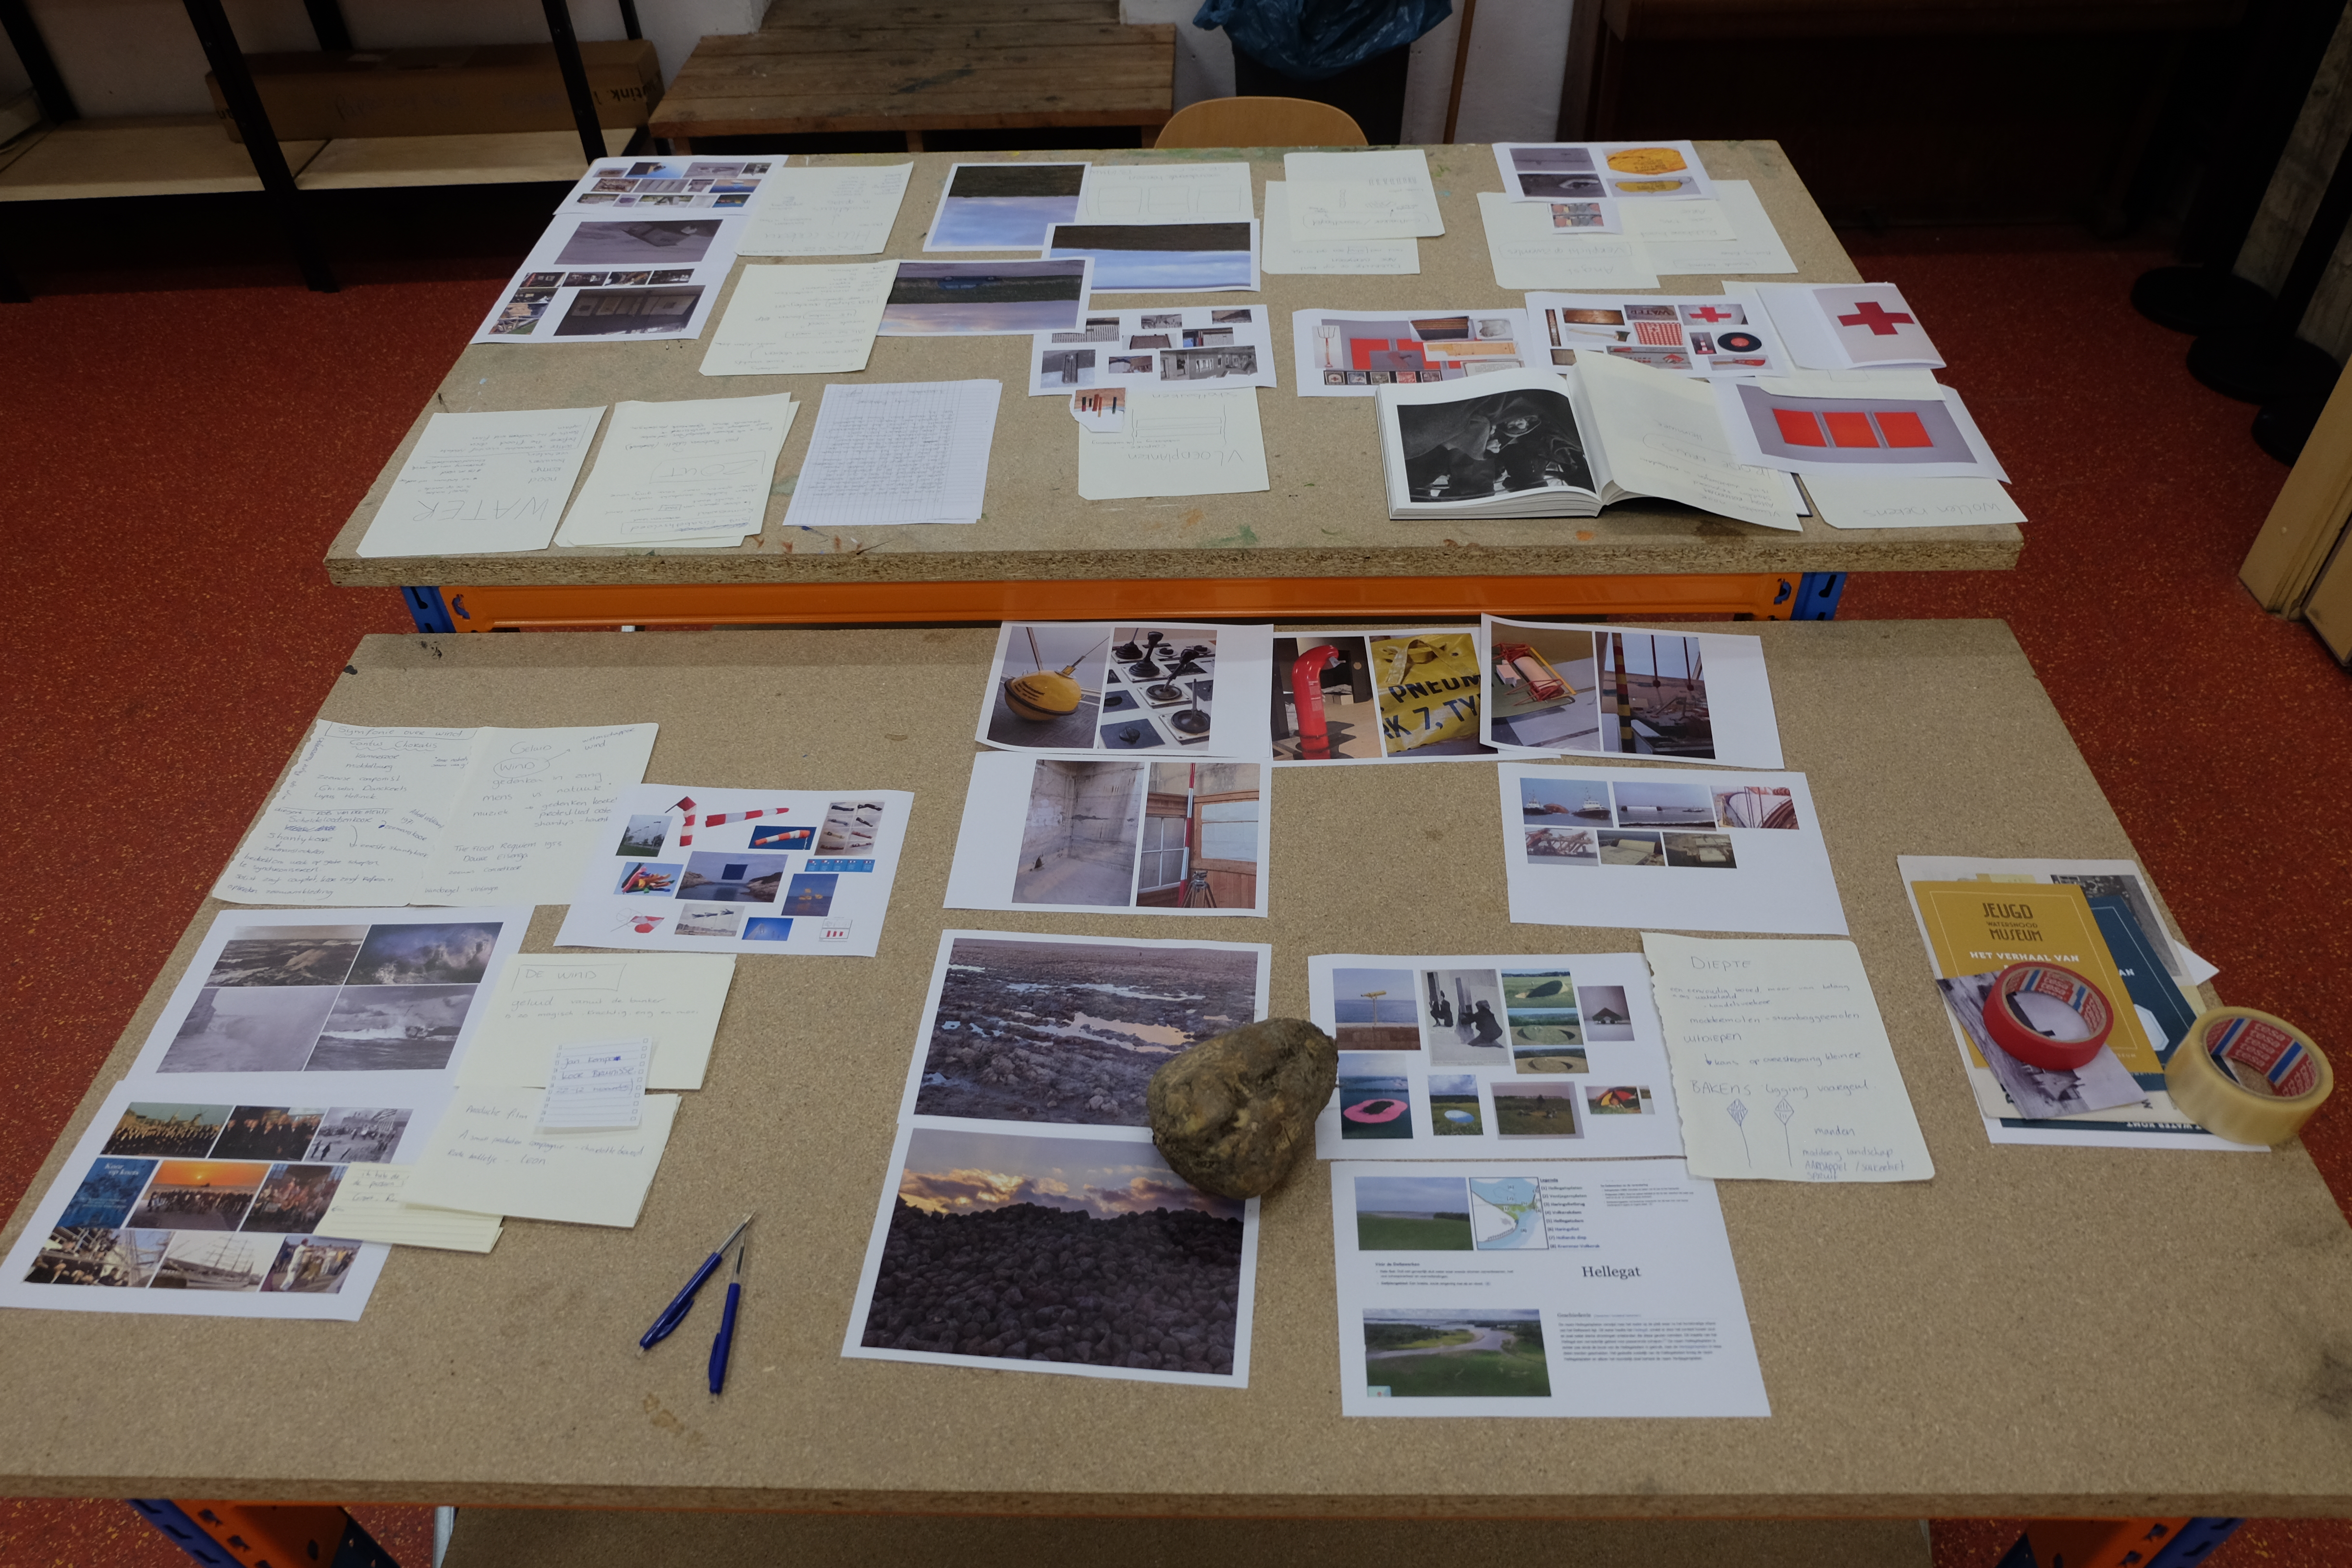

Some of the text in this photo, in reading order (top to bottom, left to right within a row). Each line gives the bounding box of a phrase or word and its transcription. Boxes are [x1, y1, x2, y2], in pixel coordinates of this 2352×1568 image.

[659, 459, 759, 478] ZOUT
[527, 476, 557, 484] nood
[412, 497, 549, 522] WATER
[1982, 903, 2034, 919] JEUGD
[1989, 928, 2044, 942] MUSEUM
[1969, 951, 2080, 962] HET VERHAAL VAN
[525, 968, 544, 979] DE
[2249, 1029, 2281, 1048] tesa
[2254, 1023, 2286, 1042] tesa
[2239, 1043, 2271, 1061] tesa
[2244, 1037, 2275, 1054] tesa
[2235, 1049, 2266, 1067] tesa
[1813, 1125, 1856, 1137] manden
[1581, 1265, 1642, 1280] Hellegat
